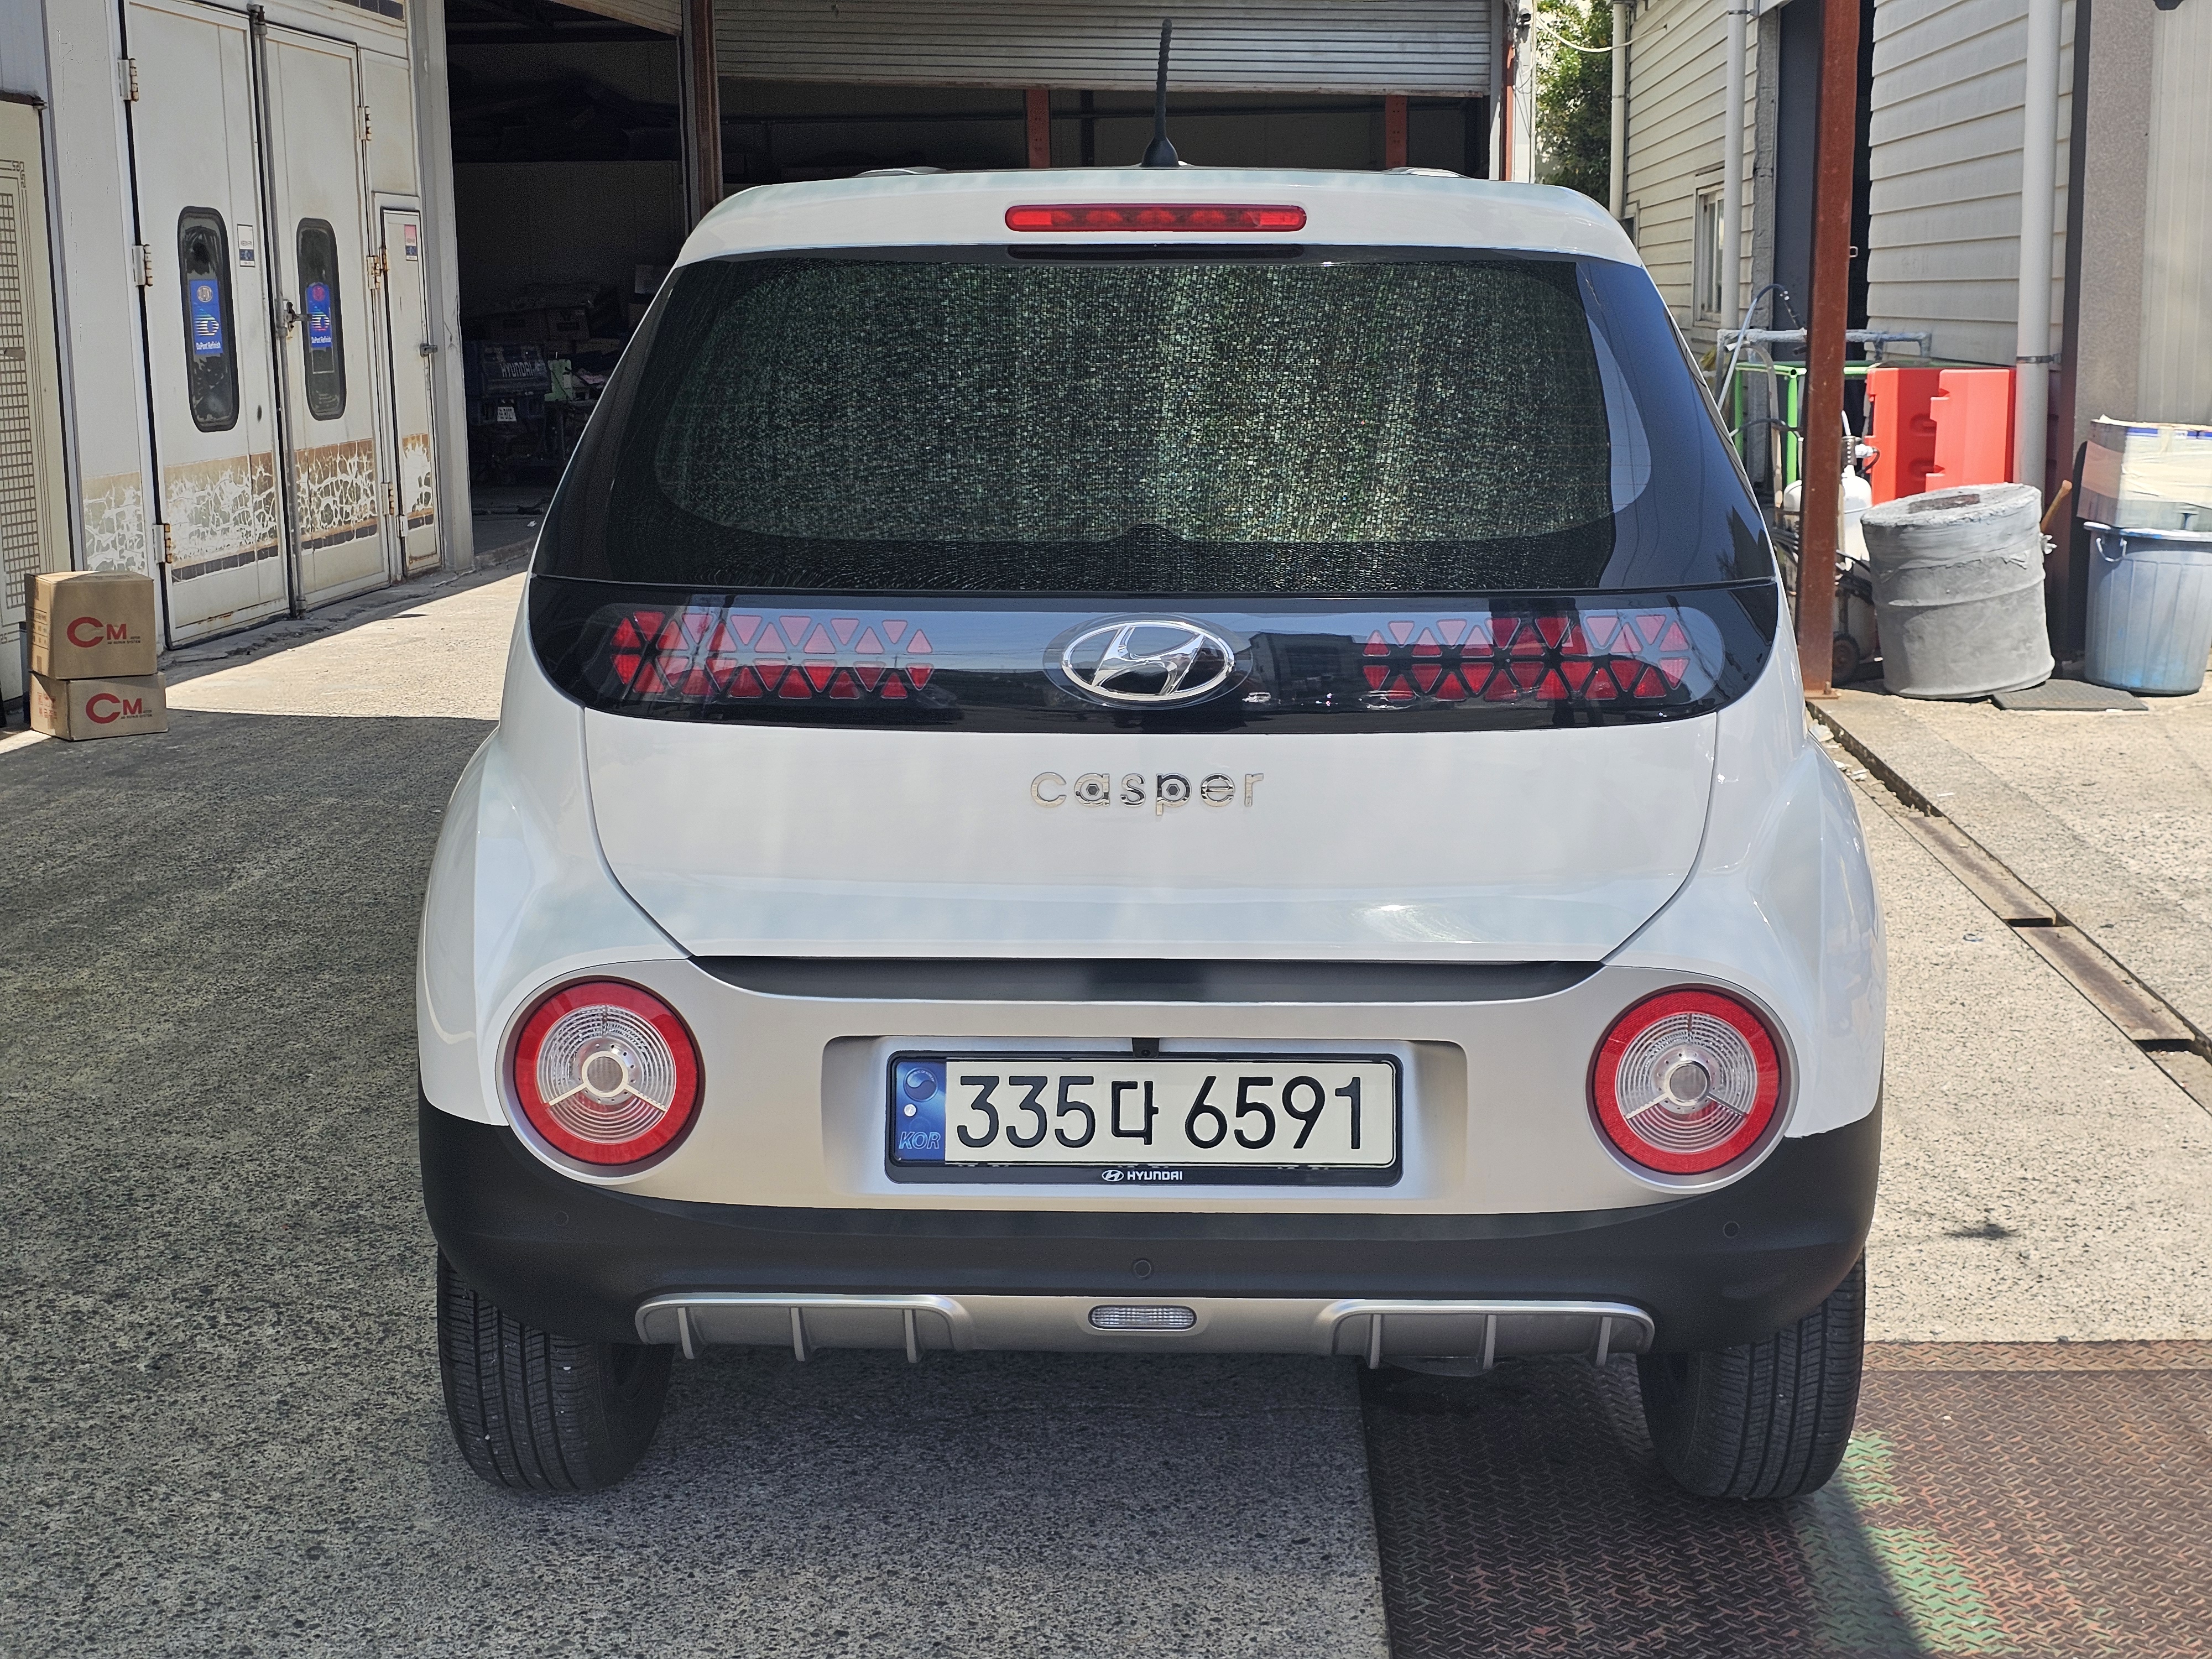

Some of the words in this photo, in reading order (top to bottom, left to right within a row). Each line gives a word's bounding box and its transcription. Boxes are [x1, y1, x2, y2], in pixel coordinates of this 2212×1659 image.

[500, 362, 534, 378] HYUNDAI
[1030, 771, 1264, 816] casper
[957, 1075, 1159, 1149] 335다
[1185, 1076, 1361, 1150] 6591
[899, 1131, 941, 1149] KOR
[1127, 1171, 1183, 1181] HYUNDAI
